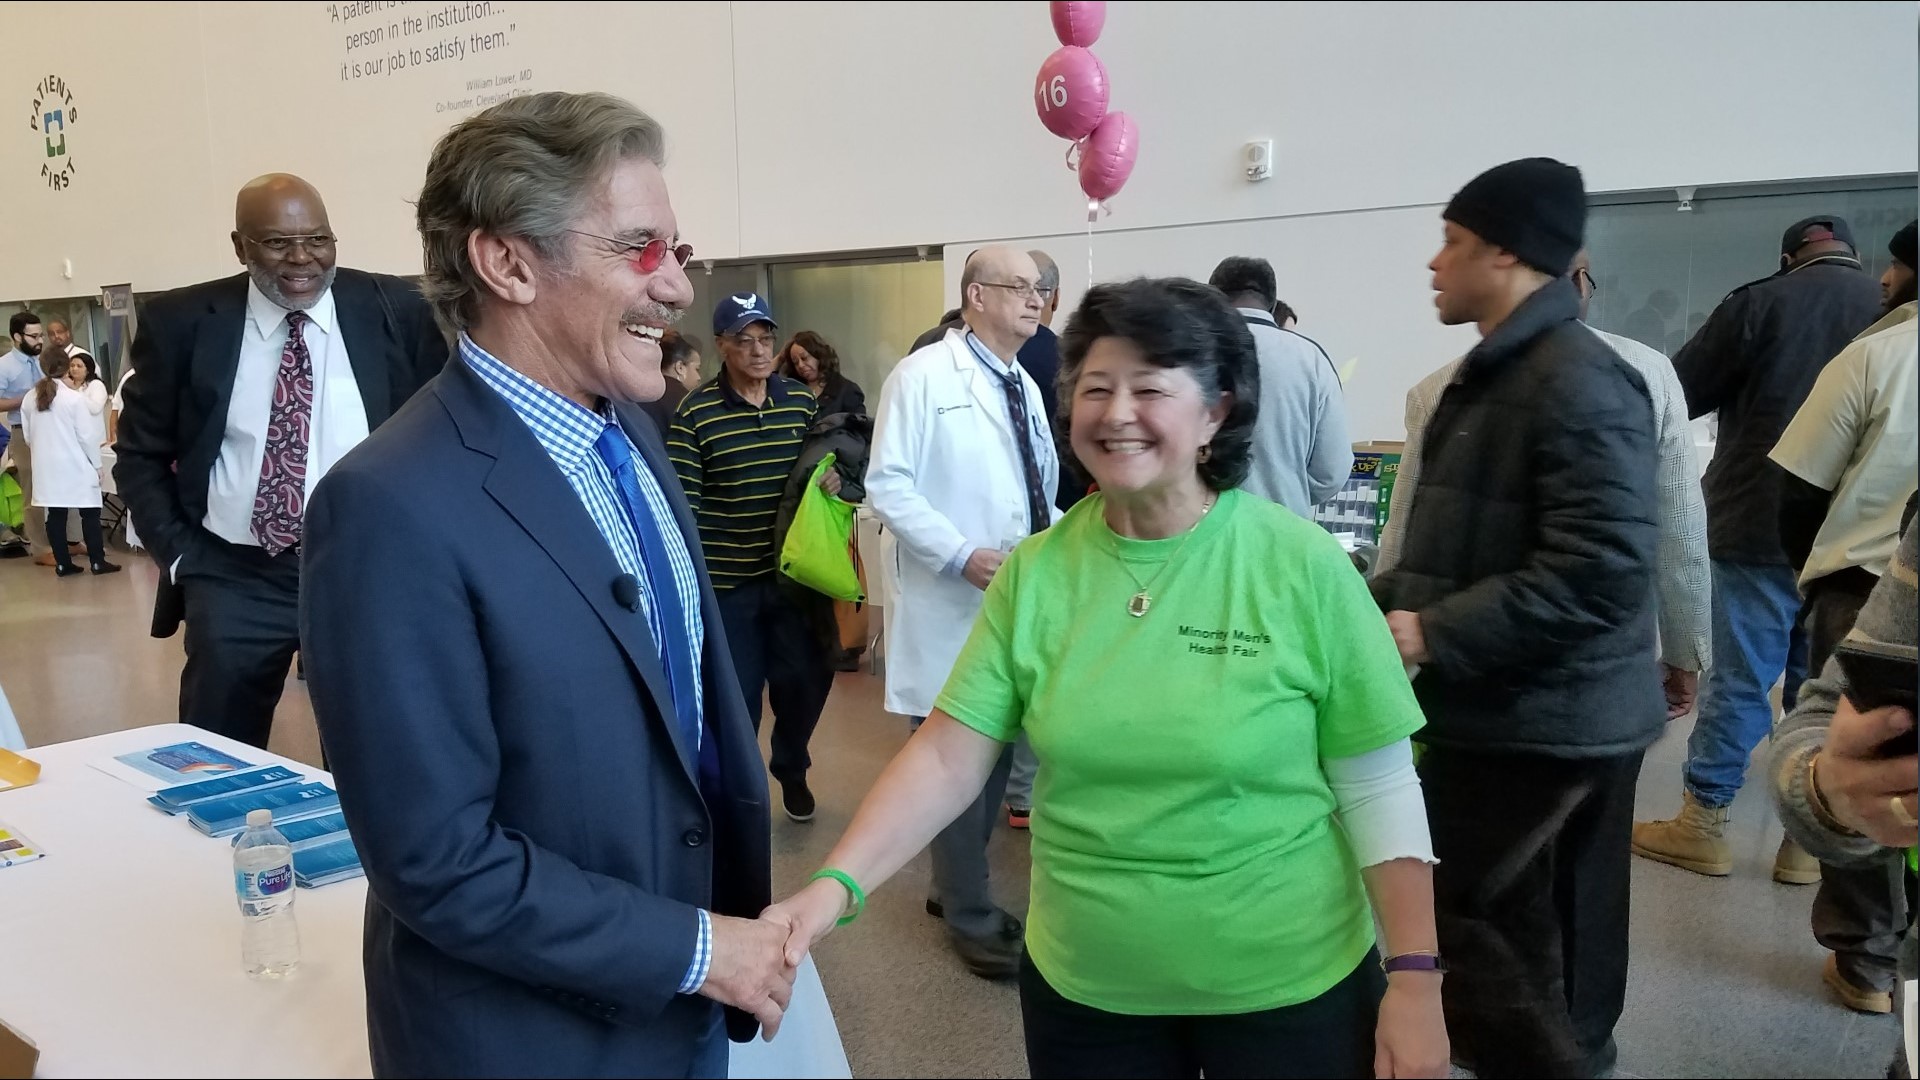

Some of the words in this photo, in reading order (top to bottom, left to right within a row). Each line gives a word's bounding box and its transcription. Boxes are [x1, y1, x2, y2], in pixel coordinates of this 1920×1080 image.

[346, 27, 384, 54] person
[388, 20, 399, 39] in
[403, 16, 423, 36] the
[427, 1, 505, 30] institution...
[340, 61, 349, 81] it
[352, 60, 362, 78] is
[364, 58, 384, 76] our
[387, 49, 406, 76] job
[410, 47, 422, 66] to
[425, 35, 466, 62] satisfy
[466, 79, 493, 91] William
[520, 68, 533, 81] MD
[1039, 75, 1068, 112] 16
[30, 75, 78, 131] PATIENTS
[41, 156, 75, 191] FIRST
[1178, 625, 1228, 642] Minority
[1232, 629, 1271, 644] Men's
[1232, 645, 1260, 658] Fair
[259, 876, 280, 887] Pure
